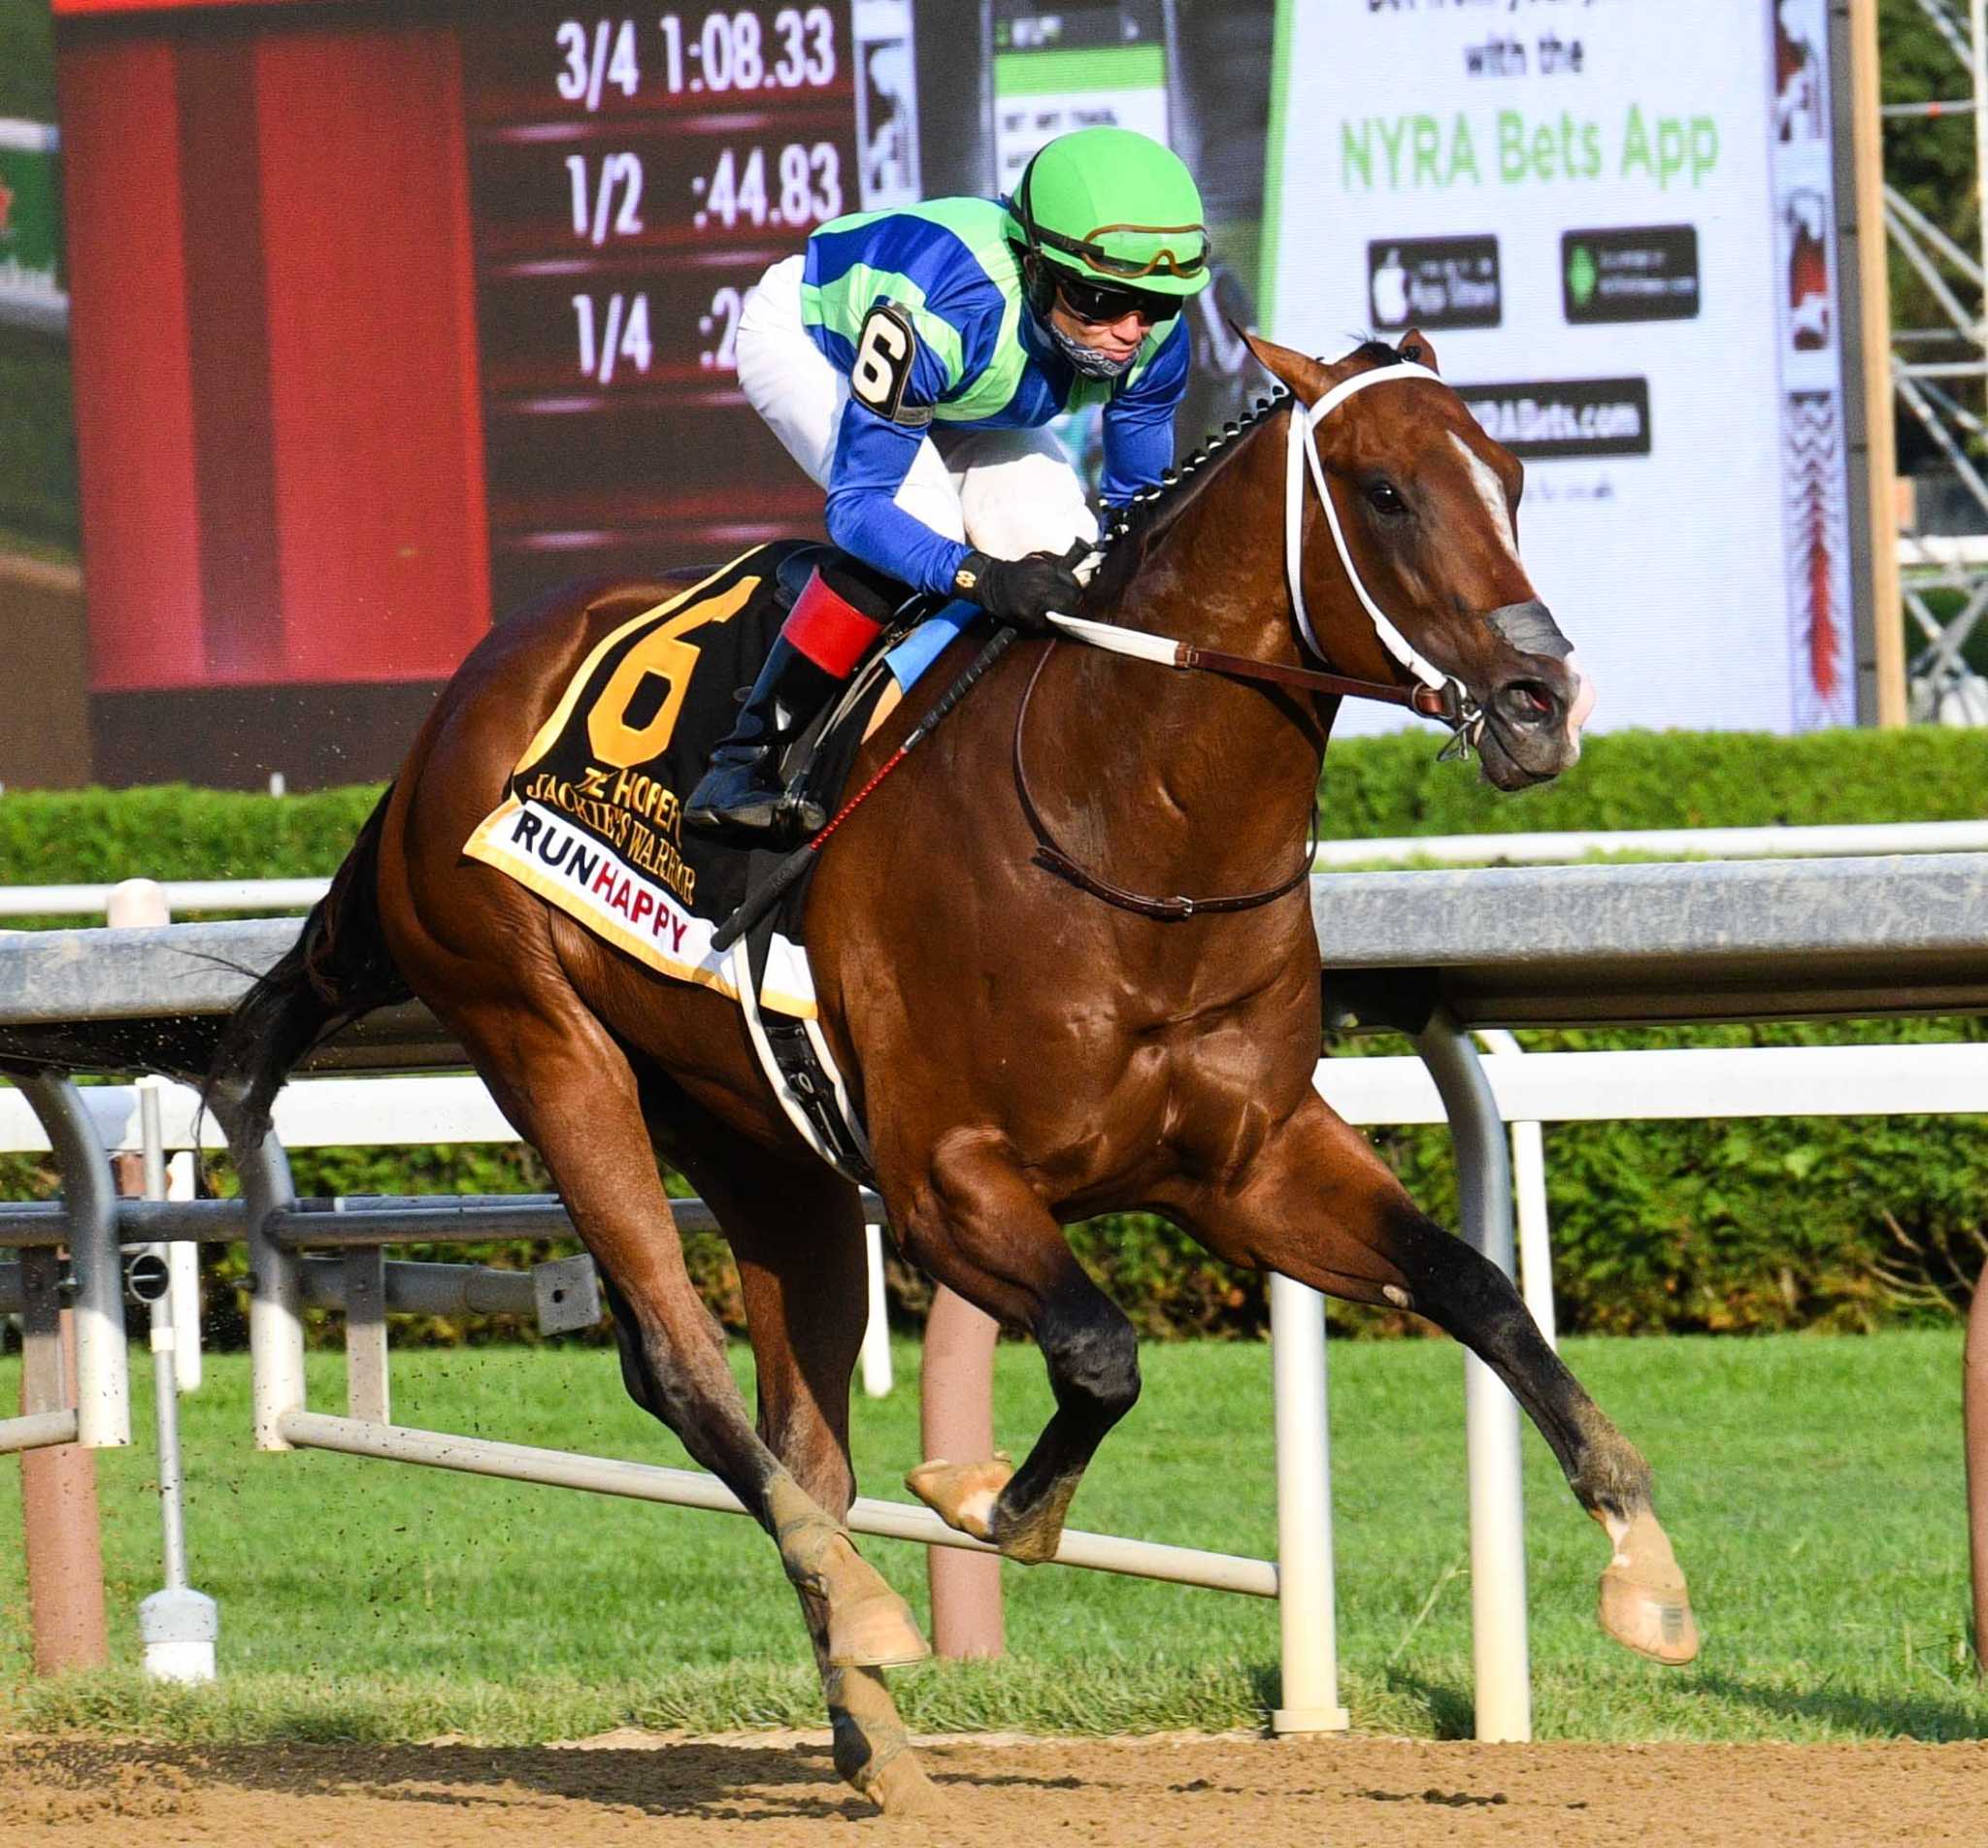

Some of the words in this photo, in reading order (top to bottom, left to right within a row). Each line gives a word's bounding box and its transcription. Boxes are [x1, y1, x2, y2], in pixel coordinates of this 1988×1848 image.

[556, 20, 639, 112] 3/4
[661, 9, 836, 93] 1:08.33
[1465, 32, 1527, 77] with
[1539, 30, 1583, 75] the
[565, 152, 644, 246] 1/2
[691, 143, 842, 229] :44.83
[1341, 113, 1481, 189] NYRA
[1496, 109, 1602, 184] Bets
[1620, 103, 1721, 189] App
[572, 293, 652, 383] 1/4
[699, 286, 759, 369] :2
[852, 313, 907, 404] 6
[1464, 399, 1641, 443] RABets.com
[586, 576, 762, 769] 6
[511, 809, 688, 954] RUNHAPPY
